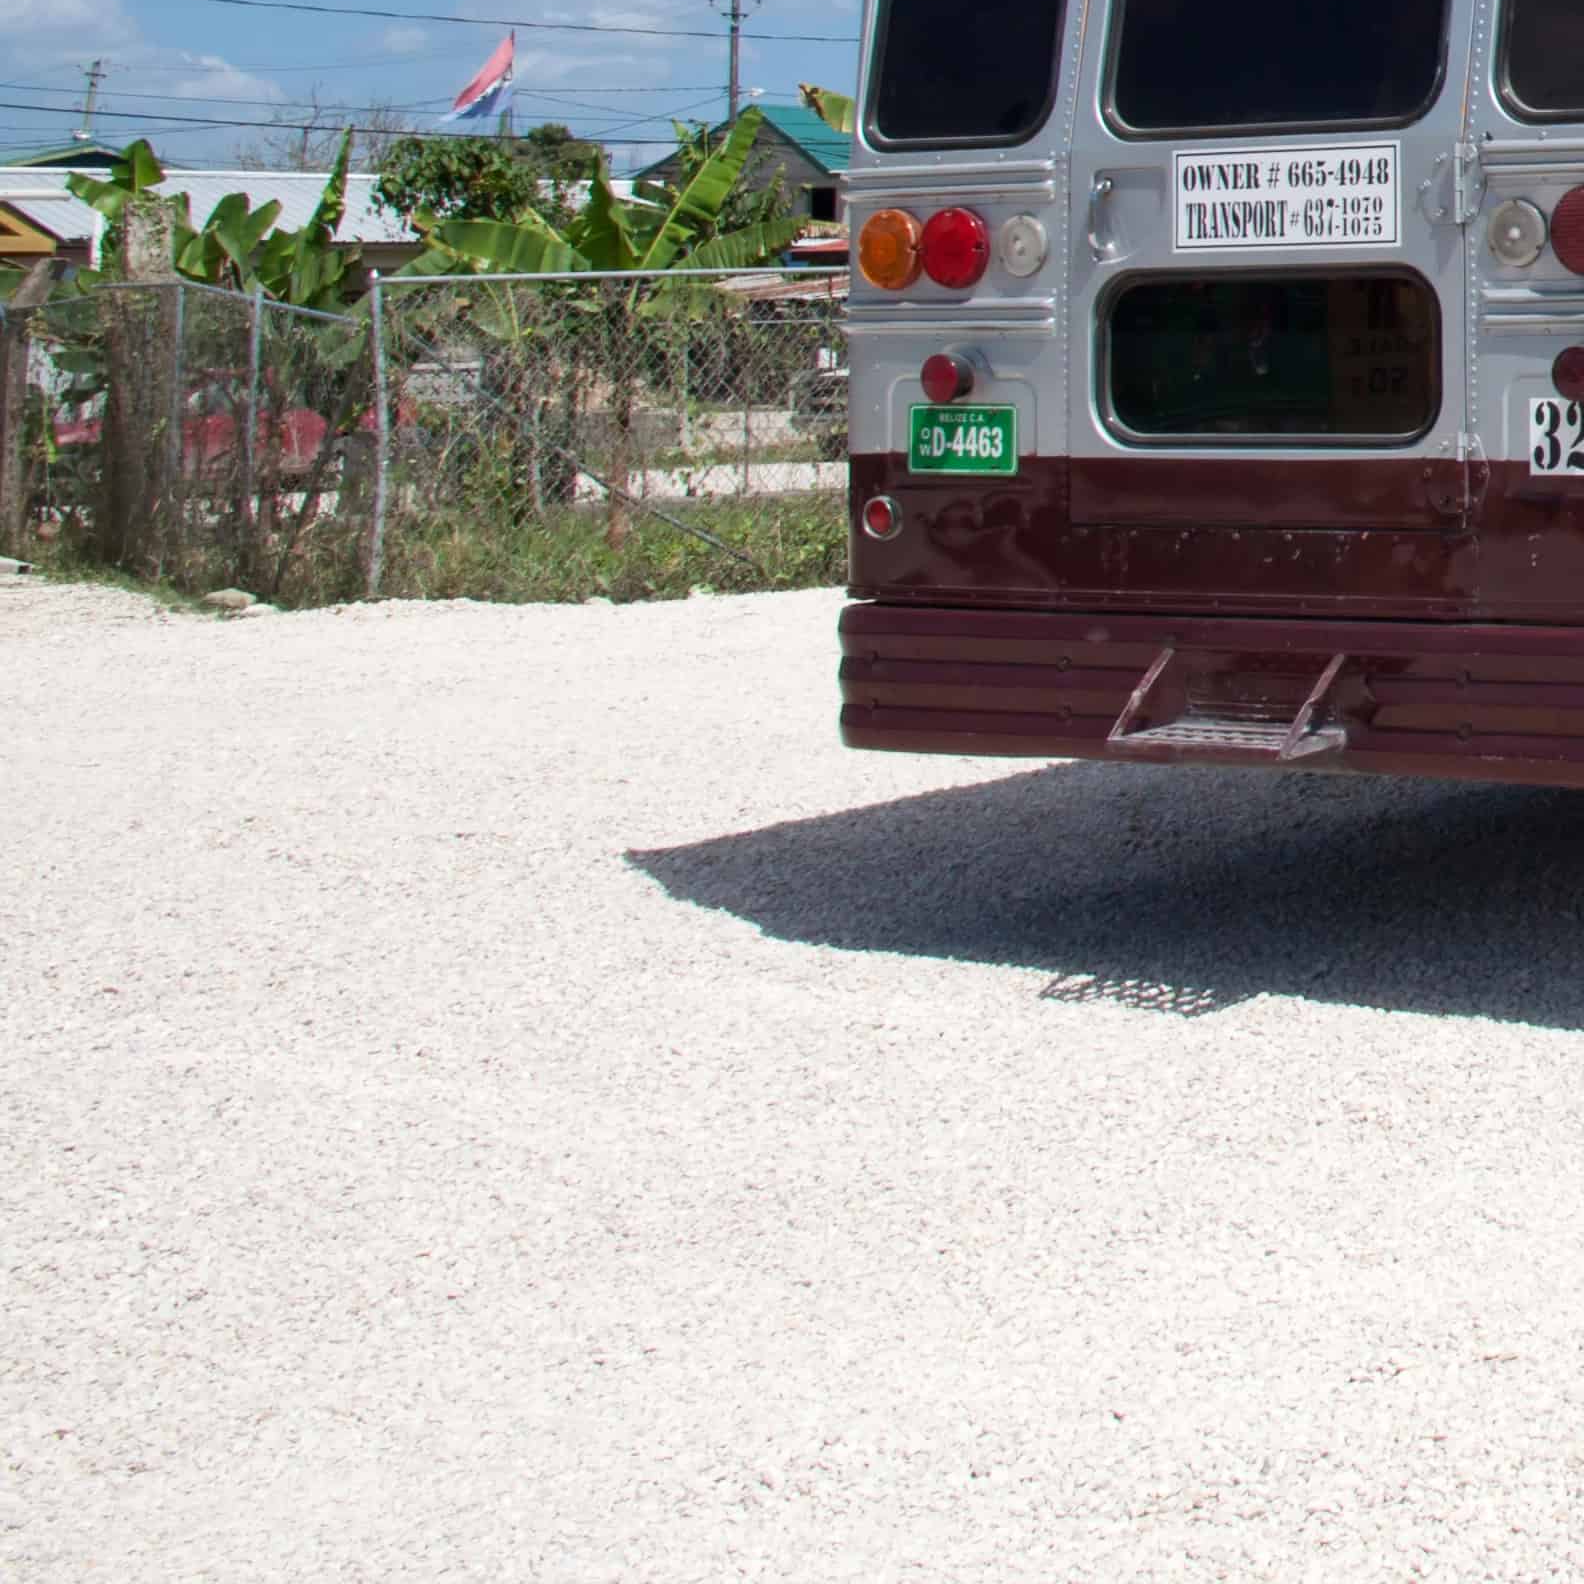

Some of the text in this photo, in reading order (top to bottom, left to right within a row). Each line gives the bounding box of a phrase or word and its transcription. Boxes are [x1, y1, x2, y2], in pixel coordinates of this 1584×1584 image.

[1183, 157, 1390, 192] OWNER # 665-4948
[1186, 200, 1288, 240] TRANSPORT
[1290, 212, 1300, 228] #
[932, 426, 1003, 458] D-4463
